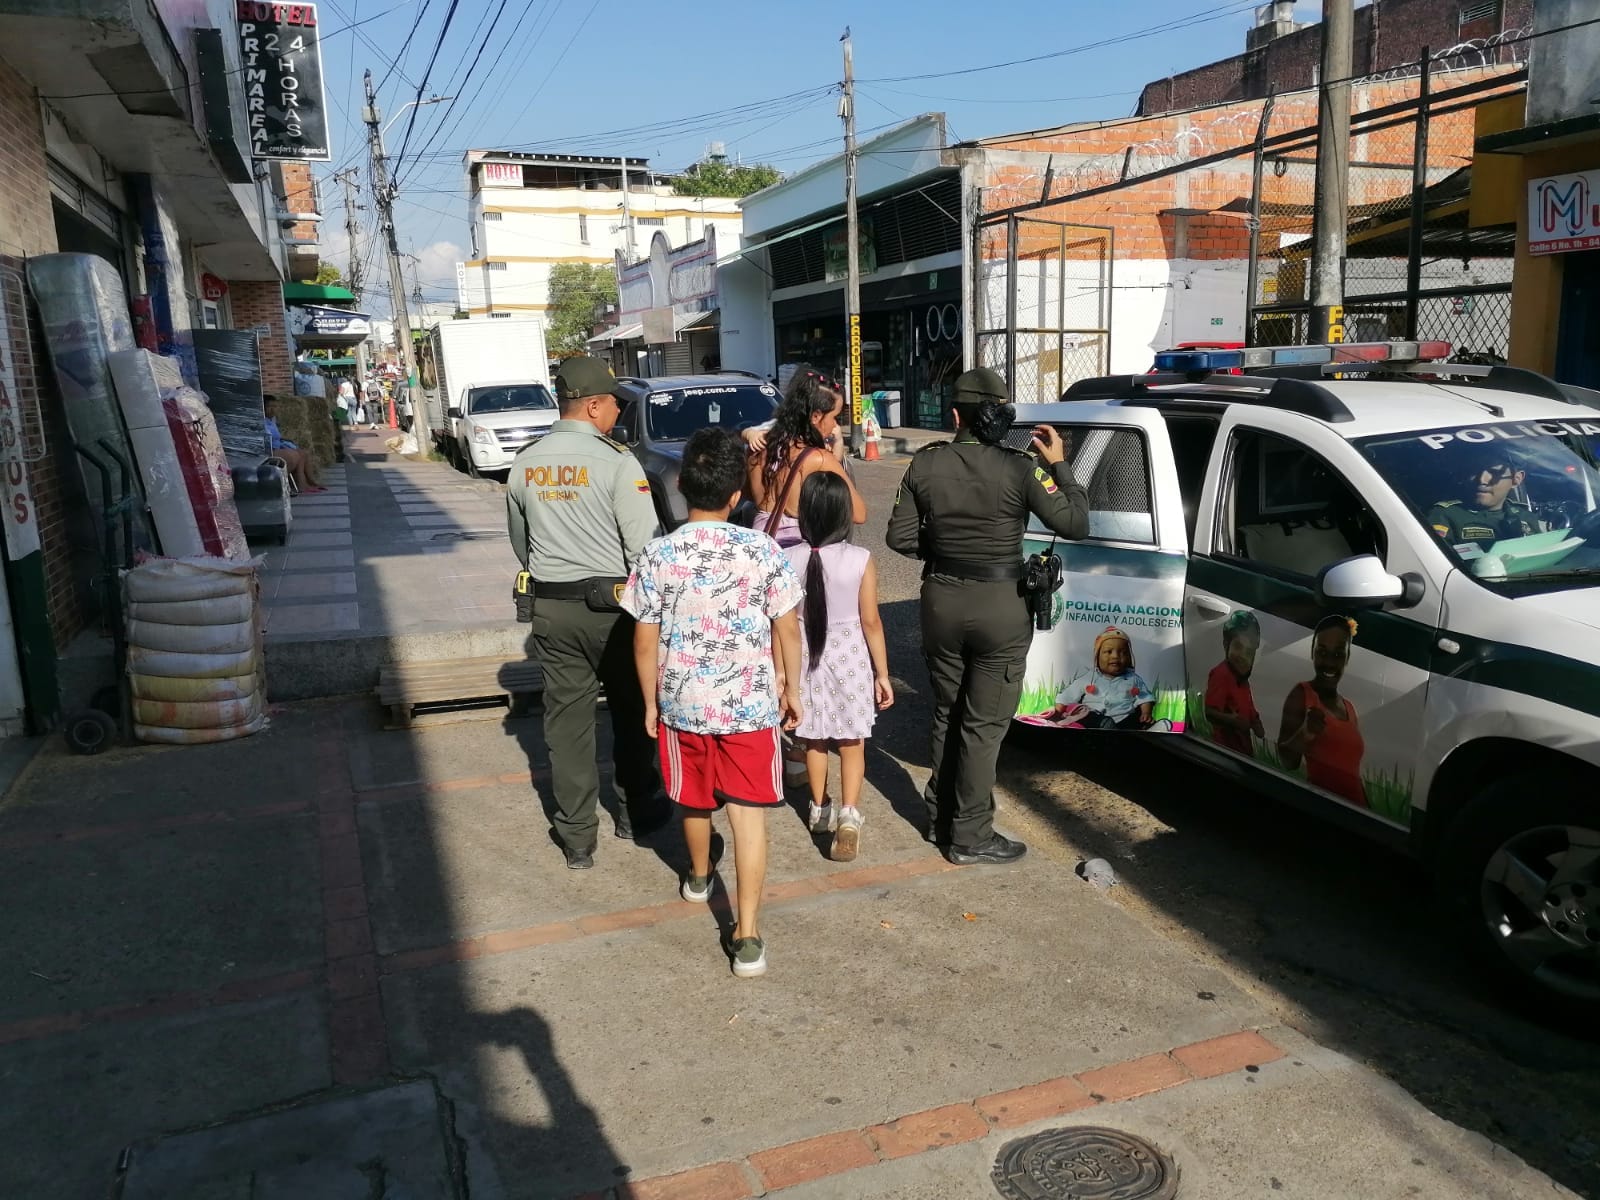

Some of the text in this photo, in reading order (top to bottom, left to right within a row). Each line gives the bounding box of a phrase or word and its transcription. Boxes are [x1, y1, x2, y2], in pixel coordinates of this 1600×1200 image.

[238, 3, 316, 26] HOTEL
[241, 23, 268, 155] PRIMAREAL
[278, 58, 302, 137] HORAS
[525, 464, 590, 488] POLICIA
[1066, 611, 1110, 624] INFANCIA
[1114, 615, 1120, 624] Y
